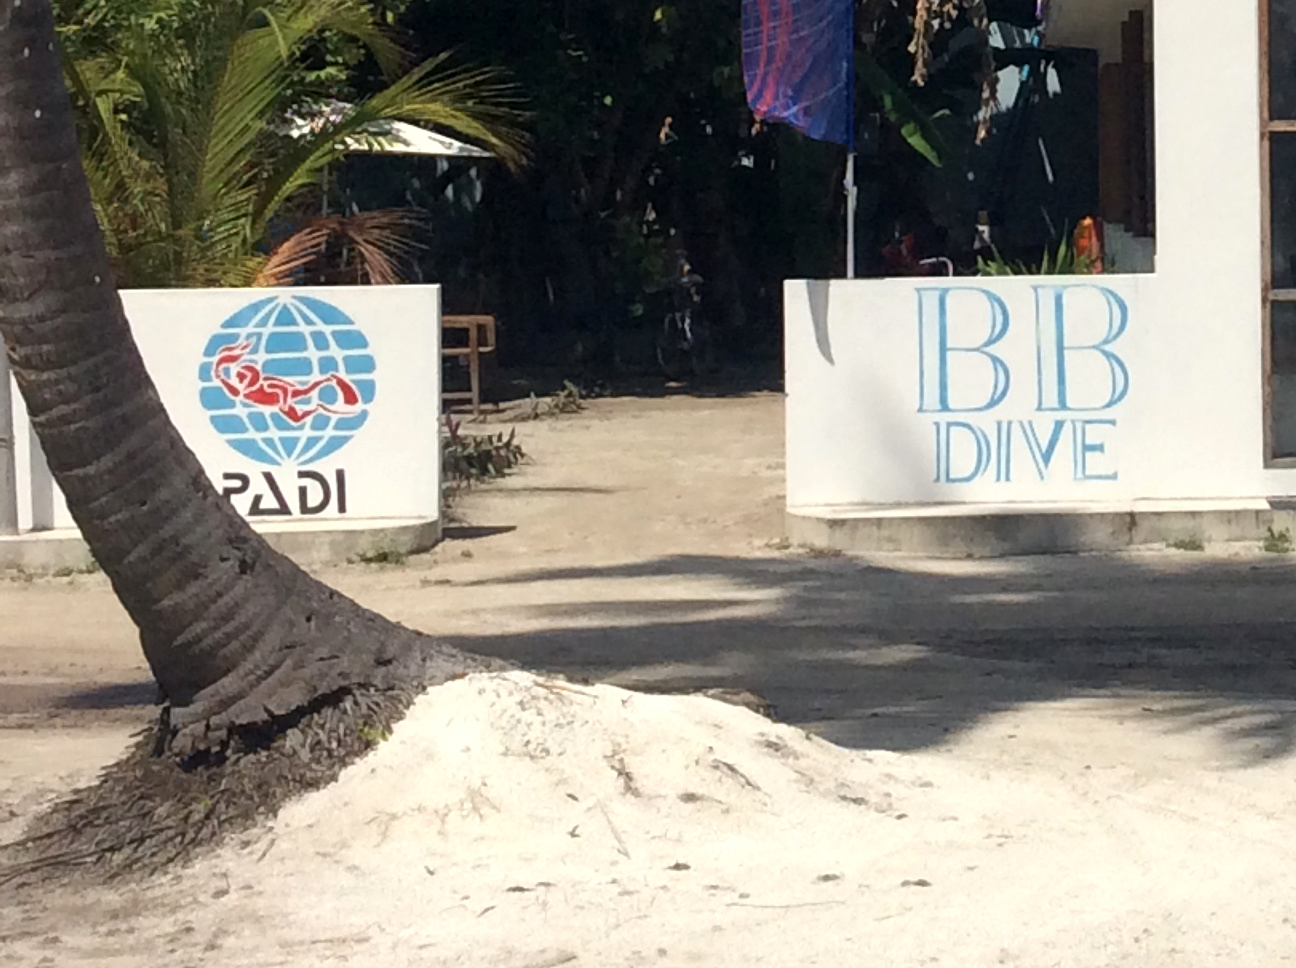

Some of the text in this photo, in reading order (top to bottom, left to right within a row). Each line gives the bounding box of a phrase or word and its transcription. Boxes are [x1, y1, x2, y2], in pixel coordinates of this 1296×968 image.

[915, 284, 1130, 413] BB
[933, 418, 1118, 483] DIVE
[222, 468, 347, 516] PADI
